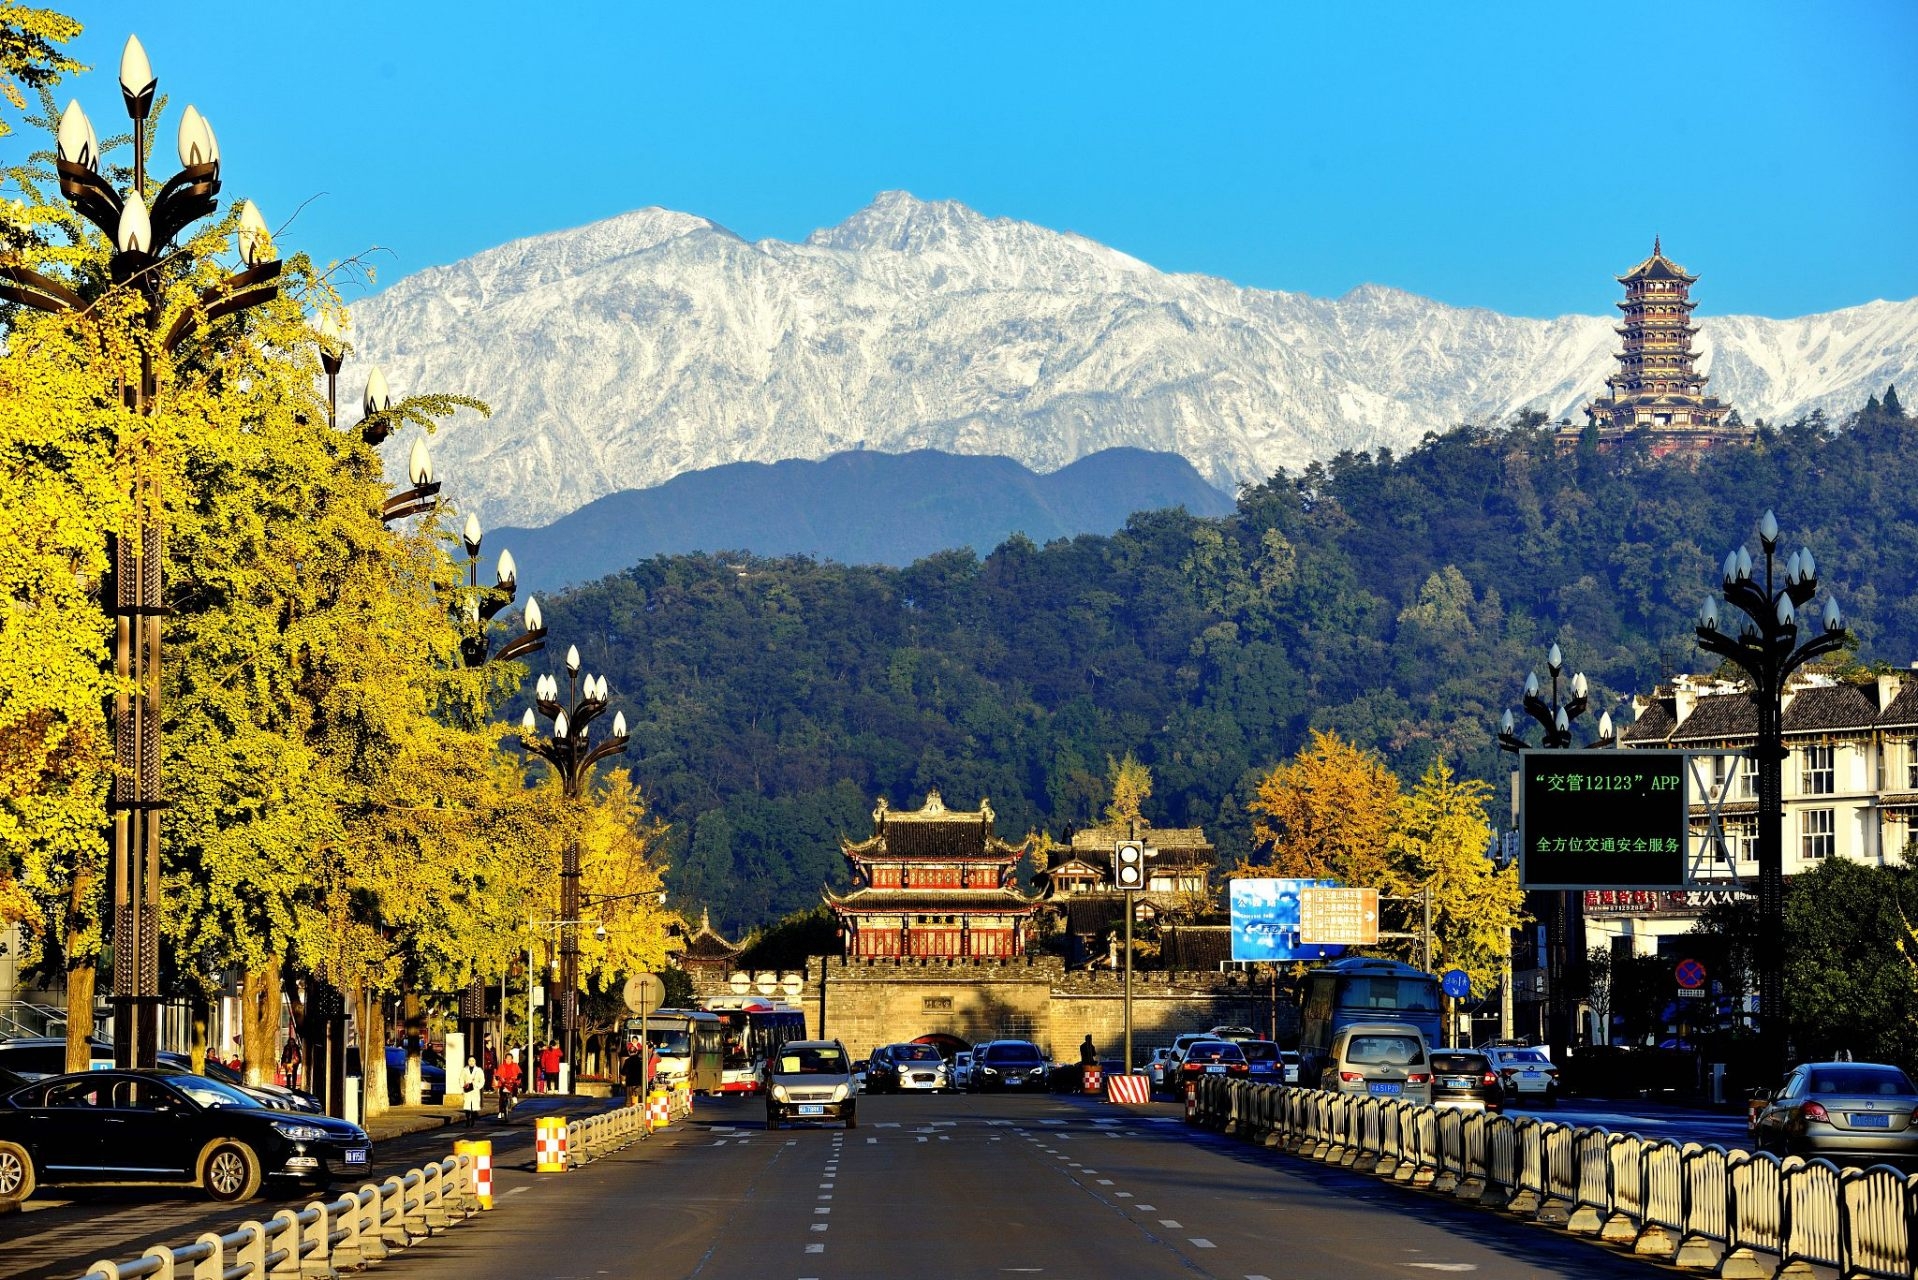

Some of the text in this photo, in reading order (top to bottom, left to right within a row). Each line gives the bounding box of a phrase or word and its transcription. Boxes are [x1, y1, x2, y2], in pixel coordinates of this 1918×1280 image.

[1651, 775, 1680, 791] APP
[1536, 836, 1680, 853] 全方位交通安全服务
